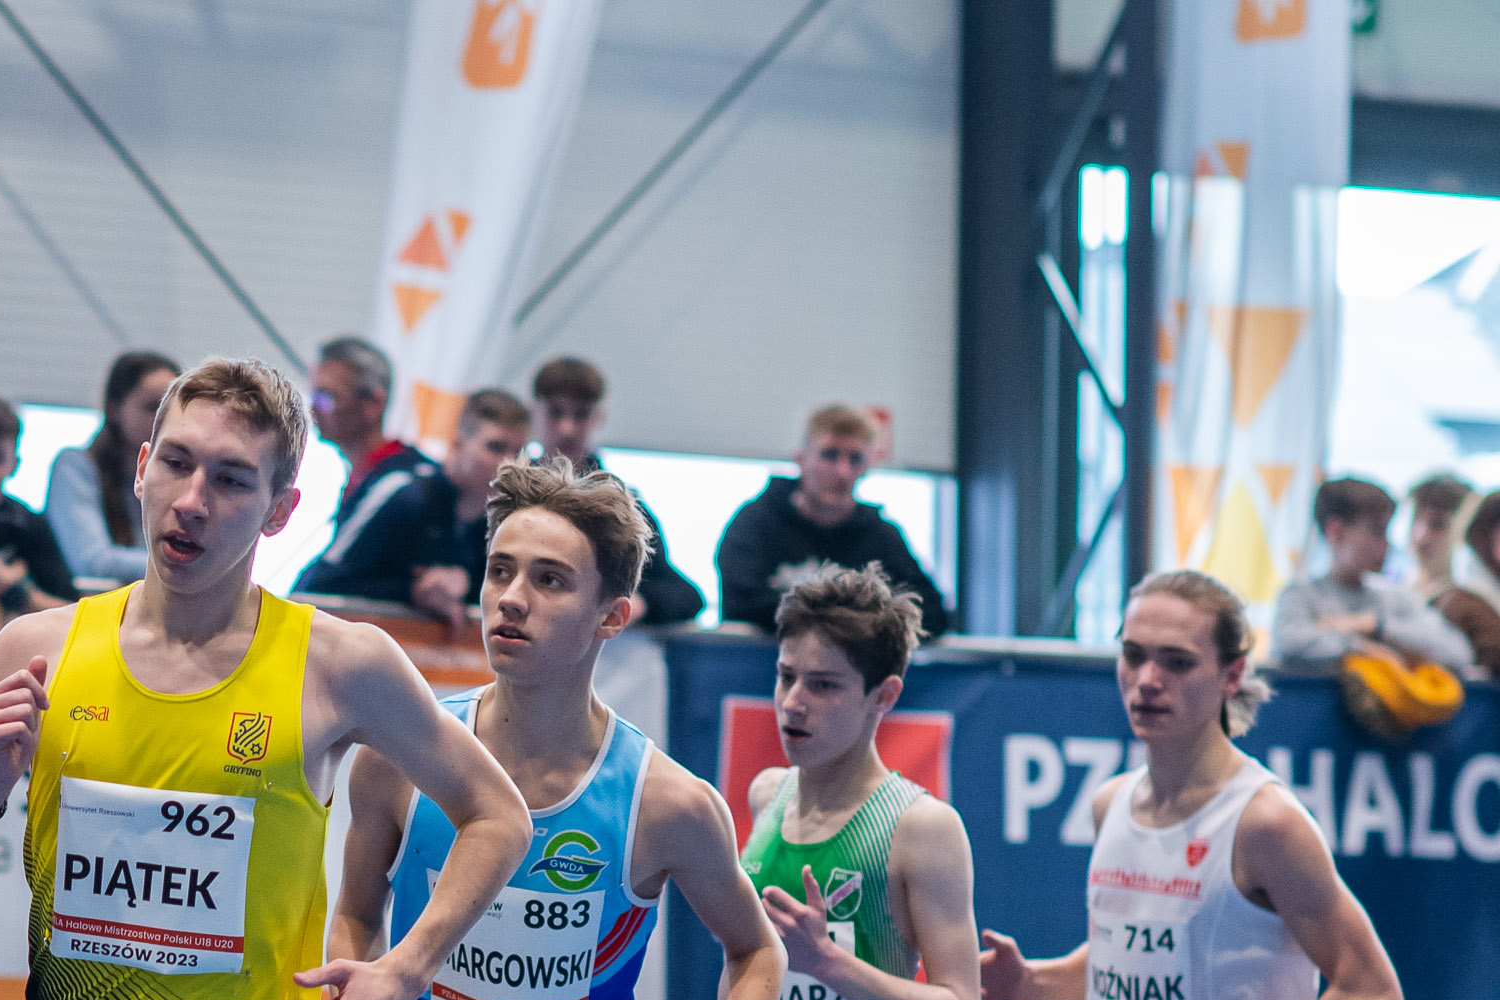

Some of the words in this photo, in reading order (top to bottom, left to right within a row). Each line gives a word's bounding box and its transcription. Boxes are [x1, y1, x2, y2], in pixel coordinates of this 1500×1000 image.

[223, 764, 262, 777] GRYFINO
[160, 800, 236, 840] 962
[549, 859, 585, 874] GWDA
[63, 853, 220, 910] PIĄTEK
[523, 899, 591, 930] 883
[104, 925, 161, 941] Mistrzostwa
[163, 933, 192, 945] Polski
[194, 938, 212, 948] U18
[214, 939, 234, 949] U20
[1124, 924, 1175, 952] 714
[70, 938, 152, 962] RZESZÓW
[156, 951, 198, 967] 2023
